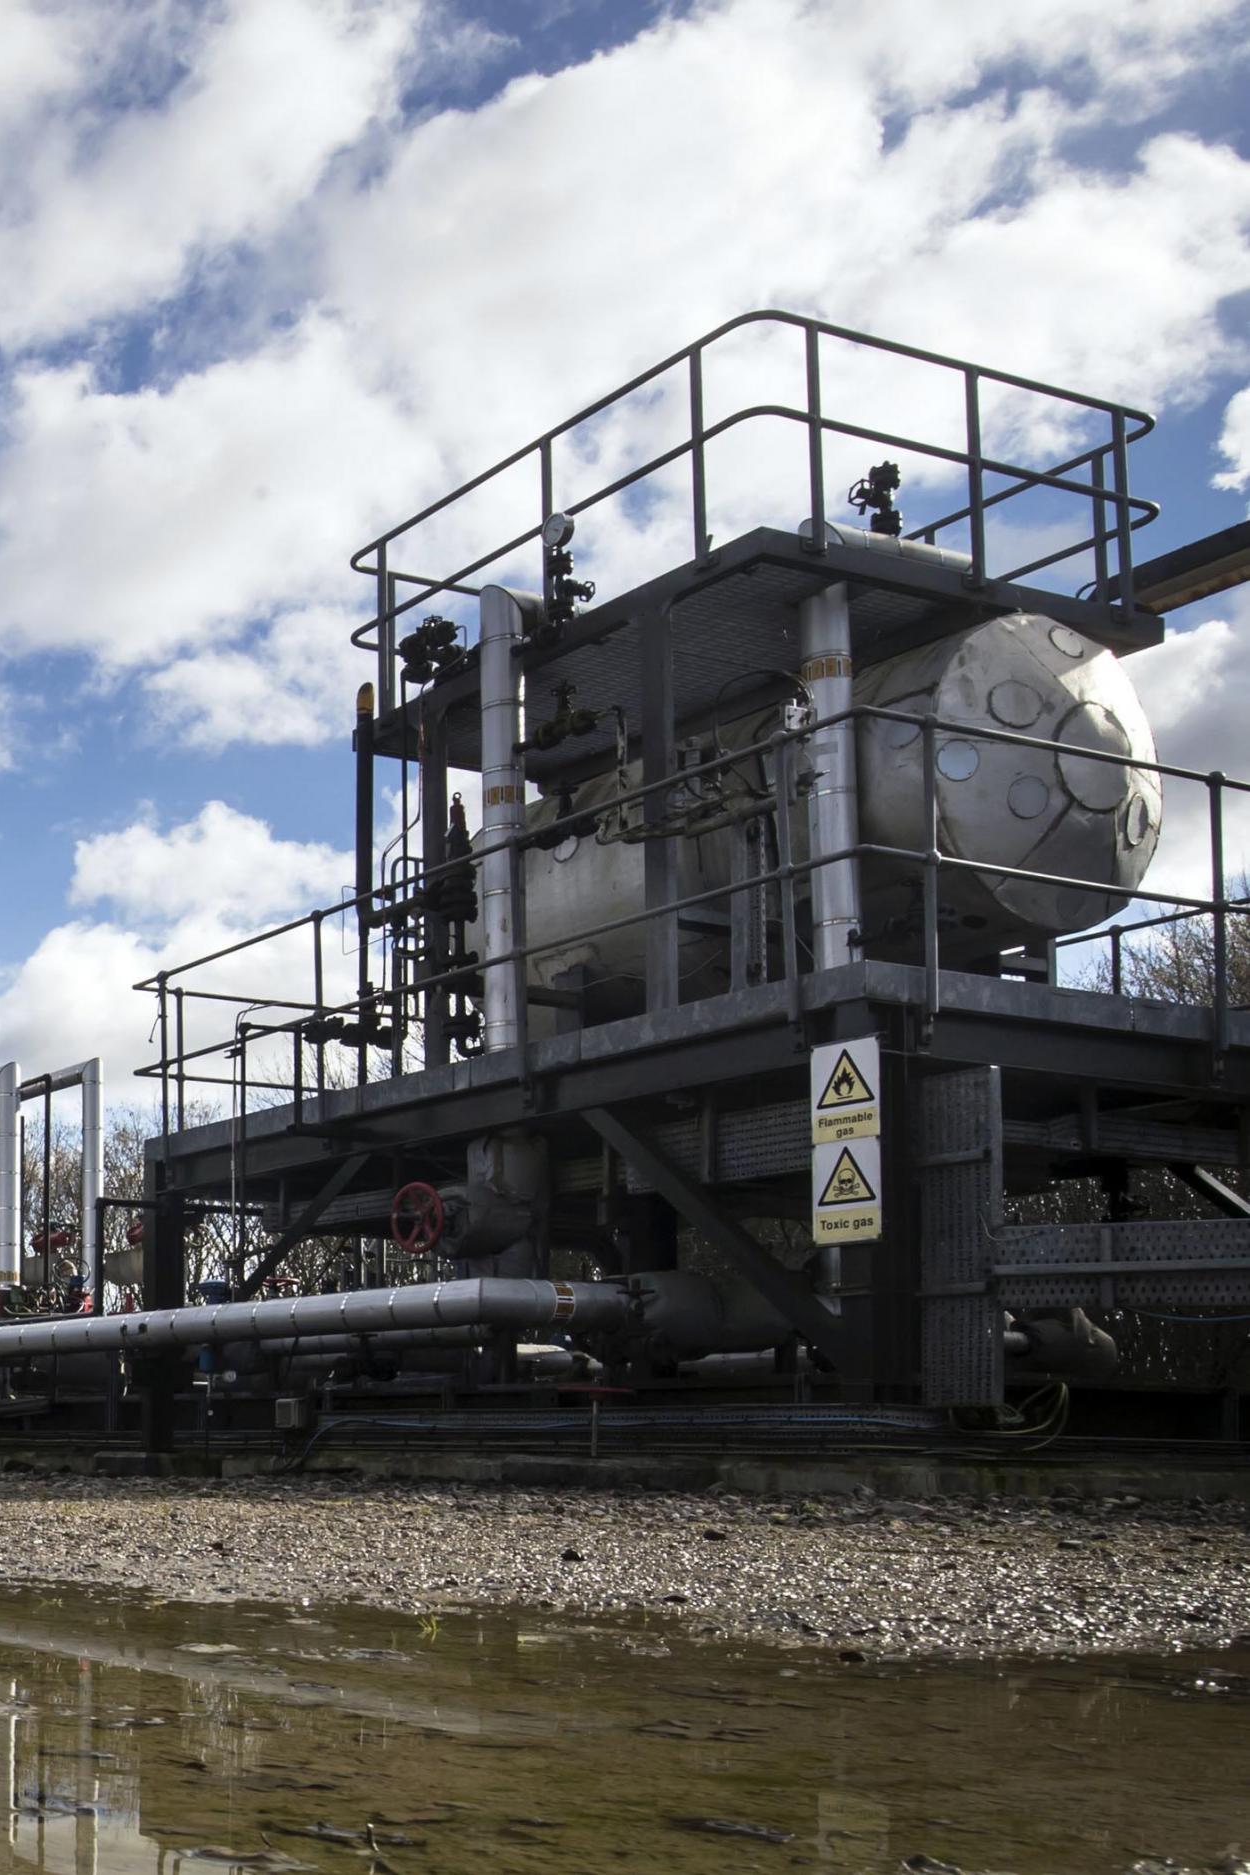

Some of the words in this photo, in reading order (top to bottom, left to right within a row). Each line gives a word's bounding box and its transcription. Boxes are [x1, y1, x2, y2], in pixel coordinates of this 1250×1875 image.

[818, 1112, 873, 1128] Flammable
[836, 1127, 854, 1138] gas
[820, 1219, 850, 1231] Toxic
[853, 1217, 874, 1230] gas
